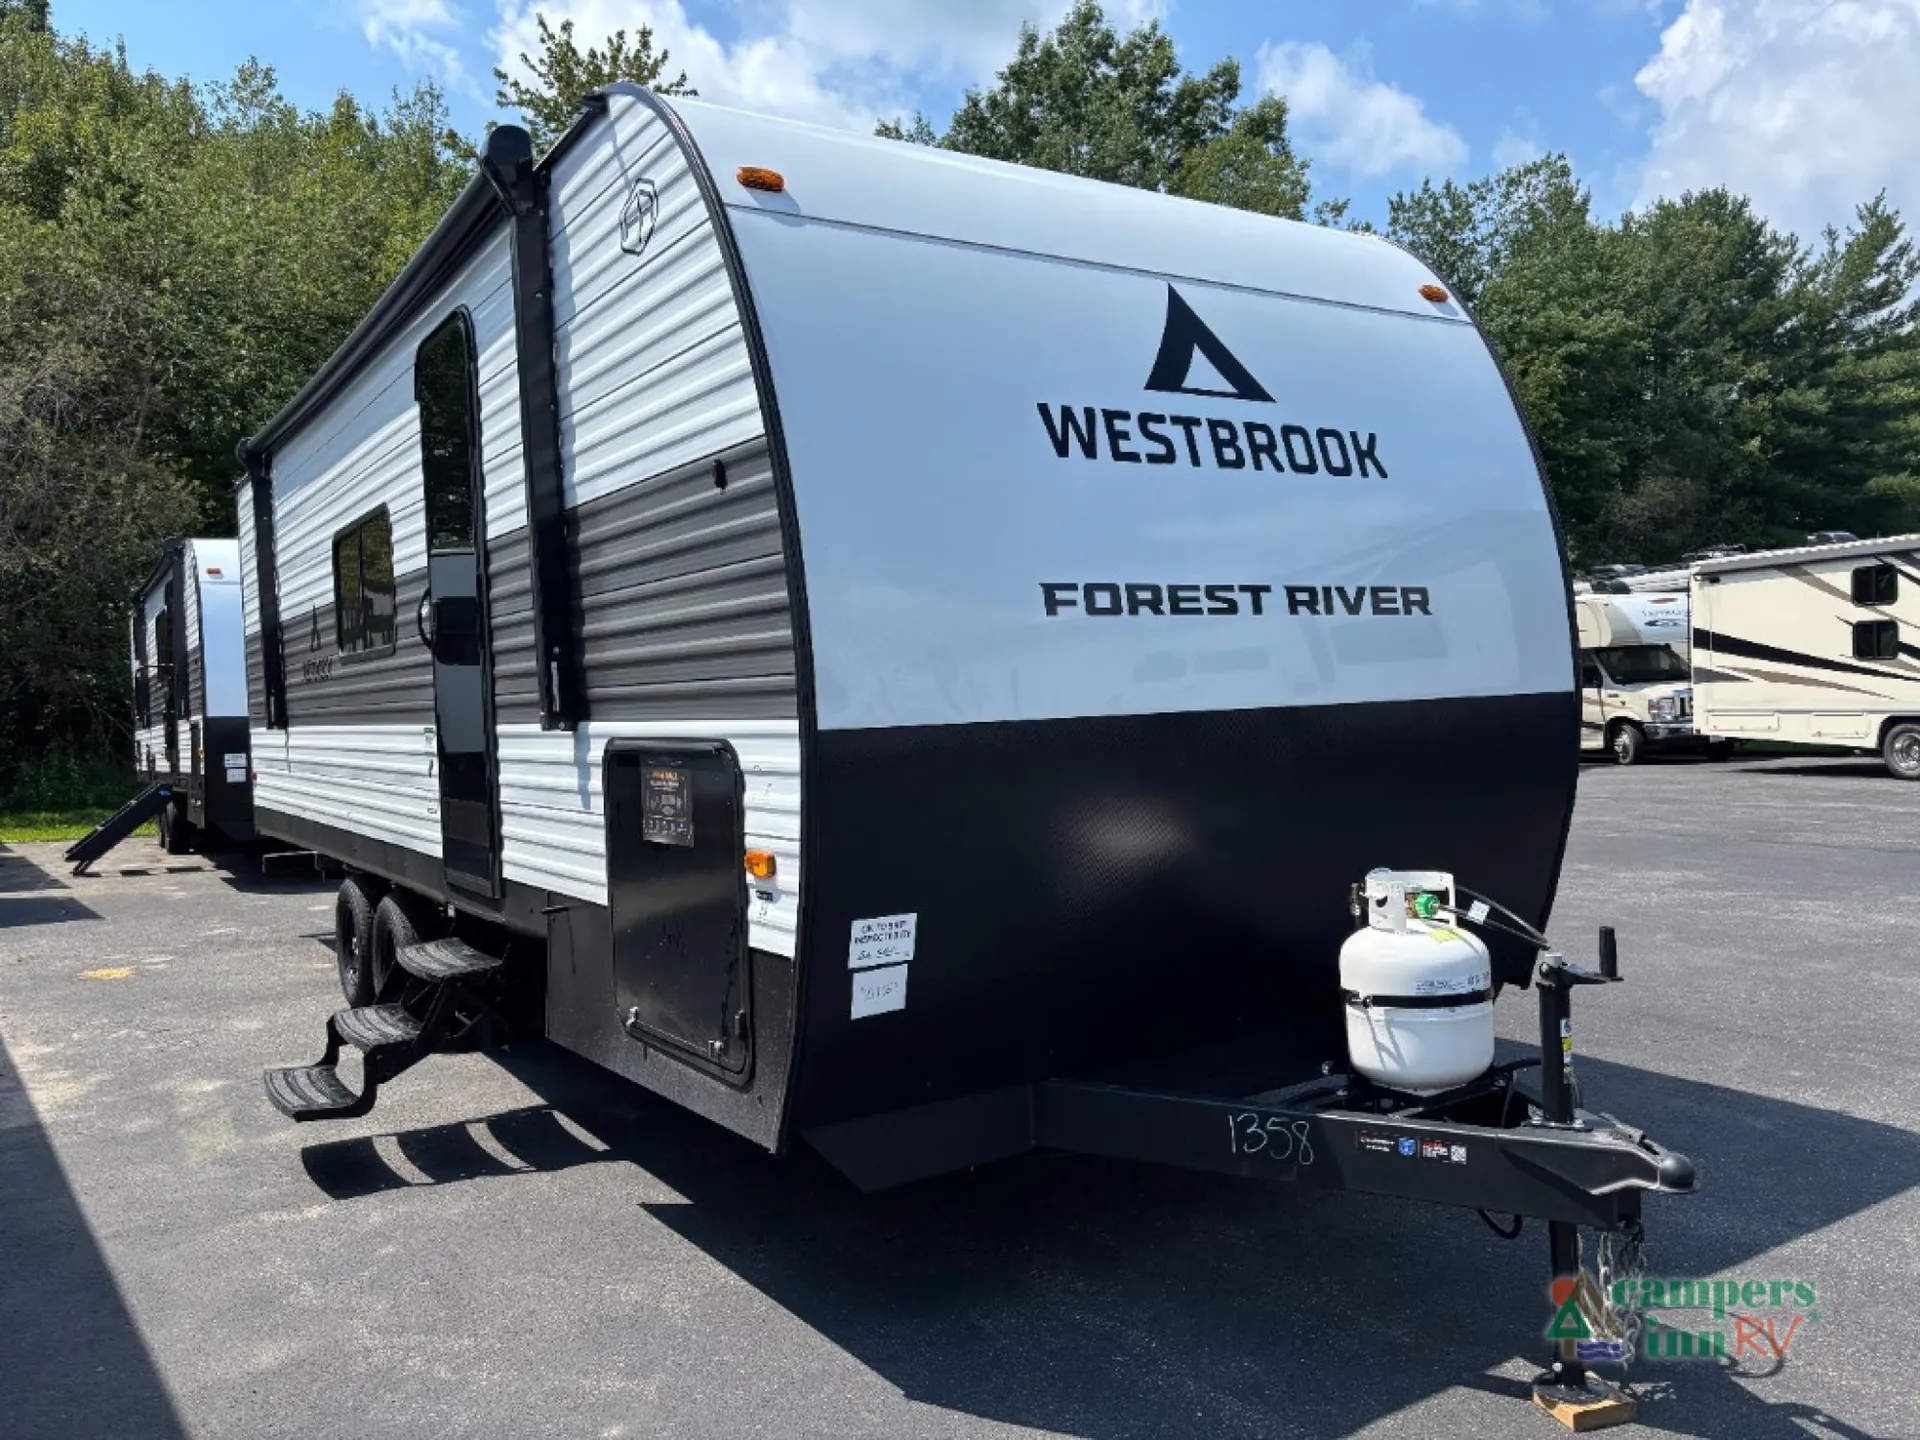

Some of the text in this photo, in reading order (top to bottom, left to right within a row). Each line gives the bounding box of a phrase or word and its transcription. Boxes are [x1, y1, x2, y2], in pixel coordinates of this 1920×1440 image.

[1037, 402, 1388, 479] WESTBROOK
[1039, 582, 1433, 616] FOREST RIVER
[1228, 1113, 1314, 1165] 1358
